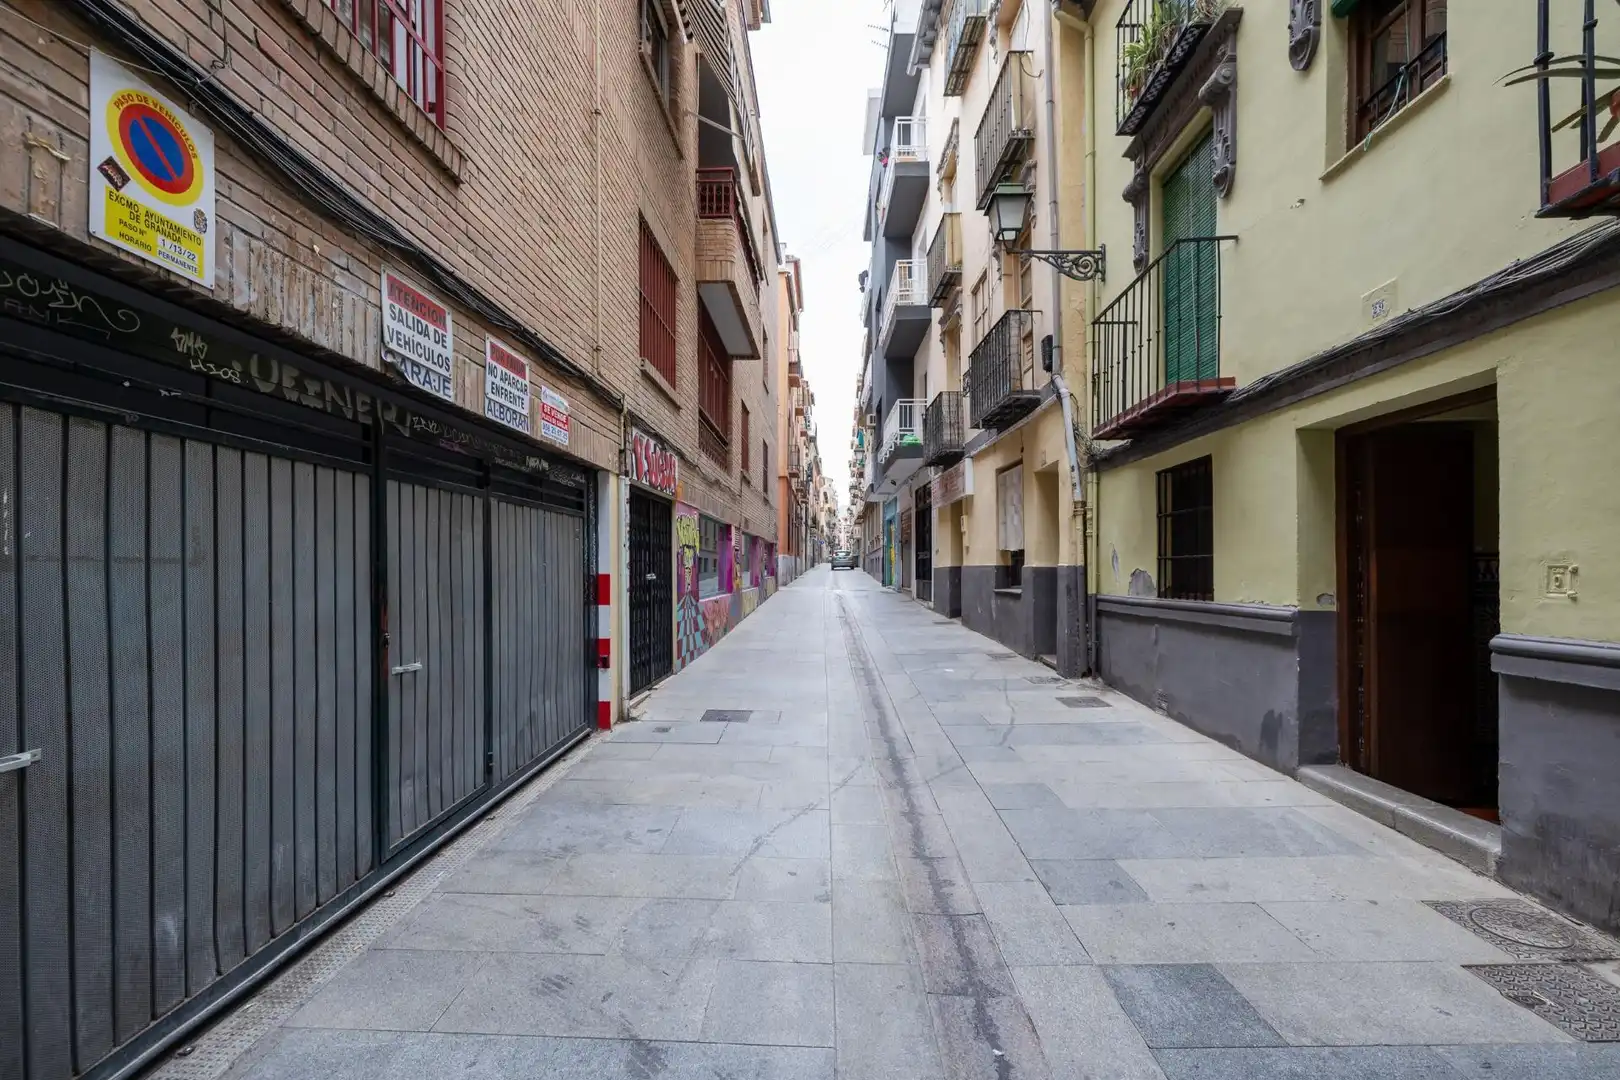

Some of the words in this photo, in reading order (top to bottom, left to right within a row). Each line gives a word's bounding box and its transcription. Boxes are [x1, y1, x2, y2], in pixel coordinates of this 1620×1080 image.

[113, 93, 134, 110] PASO
[136, 93, 149, 103] DE
[118, 218, 138, 233] PASO
[129, 211, 142, 224] DE
[144, 220, 182, 245] GRANADA
[144, 210, 202, 246] AYUNTAMIENTO
[118, 232, 152, 252] HORARIO
[158, 250, 198, 274] PERMANENTE
[389, 302, 431, 341] SALIDA
[433, 328, 448, 349] DE
[387, 324, 451, 373] VEHÍCULOS
[488, 362, 498, 379] NO
[500, 369, 529, 396] APARCAR
[491, 382, 525, 410] ENFRENTE
